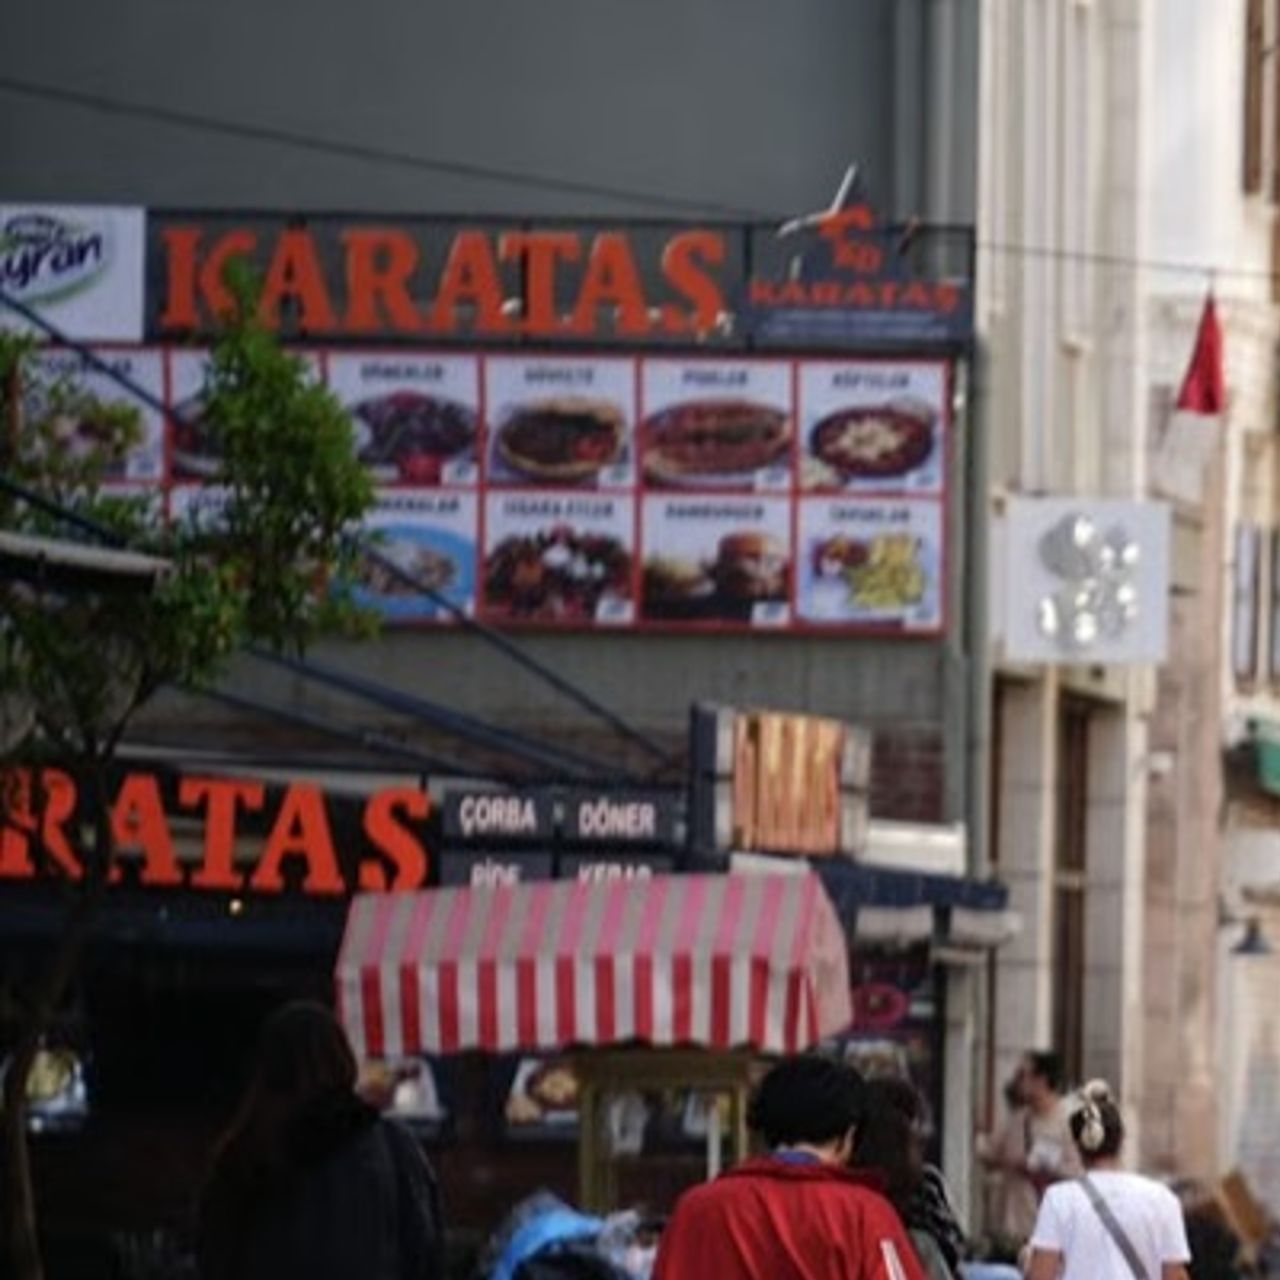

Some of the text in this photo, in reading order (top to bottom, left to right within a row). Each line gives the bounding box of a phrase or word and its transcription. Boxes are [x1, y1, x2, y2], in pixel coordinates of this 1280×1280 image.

[0, 232, 103, 290] yran
[161, 226, 728, 336] KARATAS
[460, 795, 537, 837] ÇORBA
[578, 797, 655, 836] DÖNER
